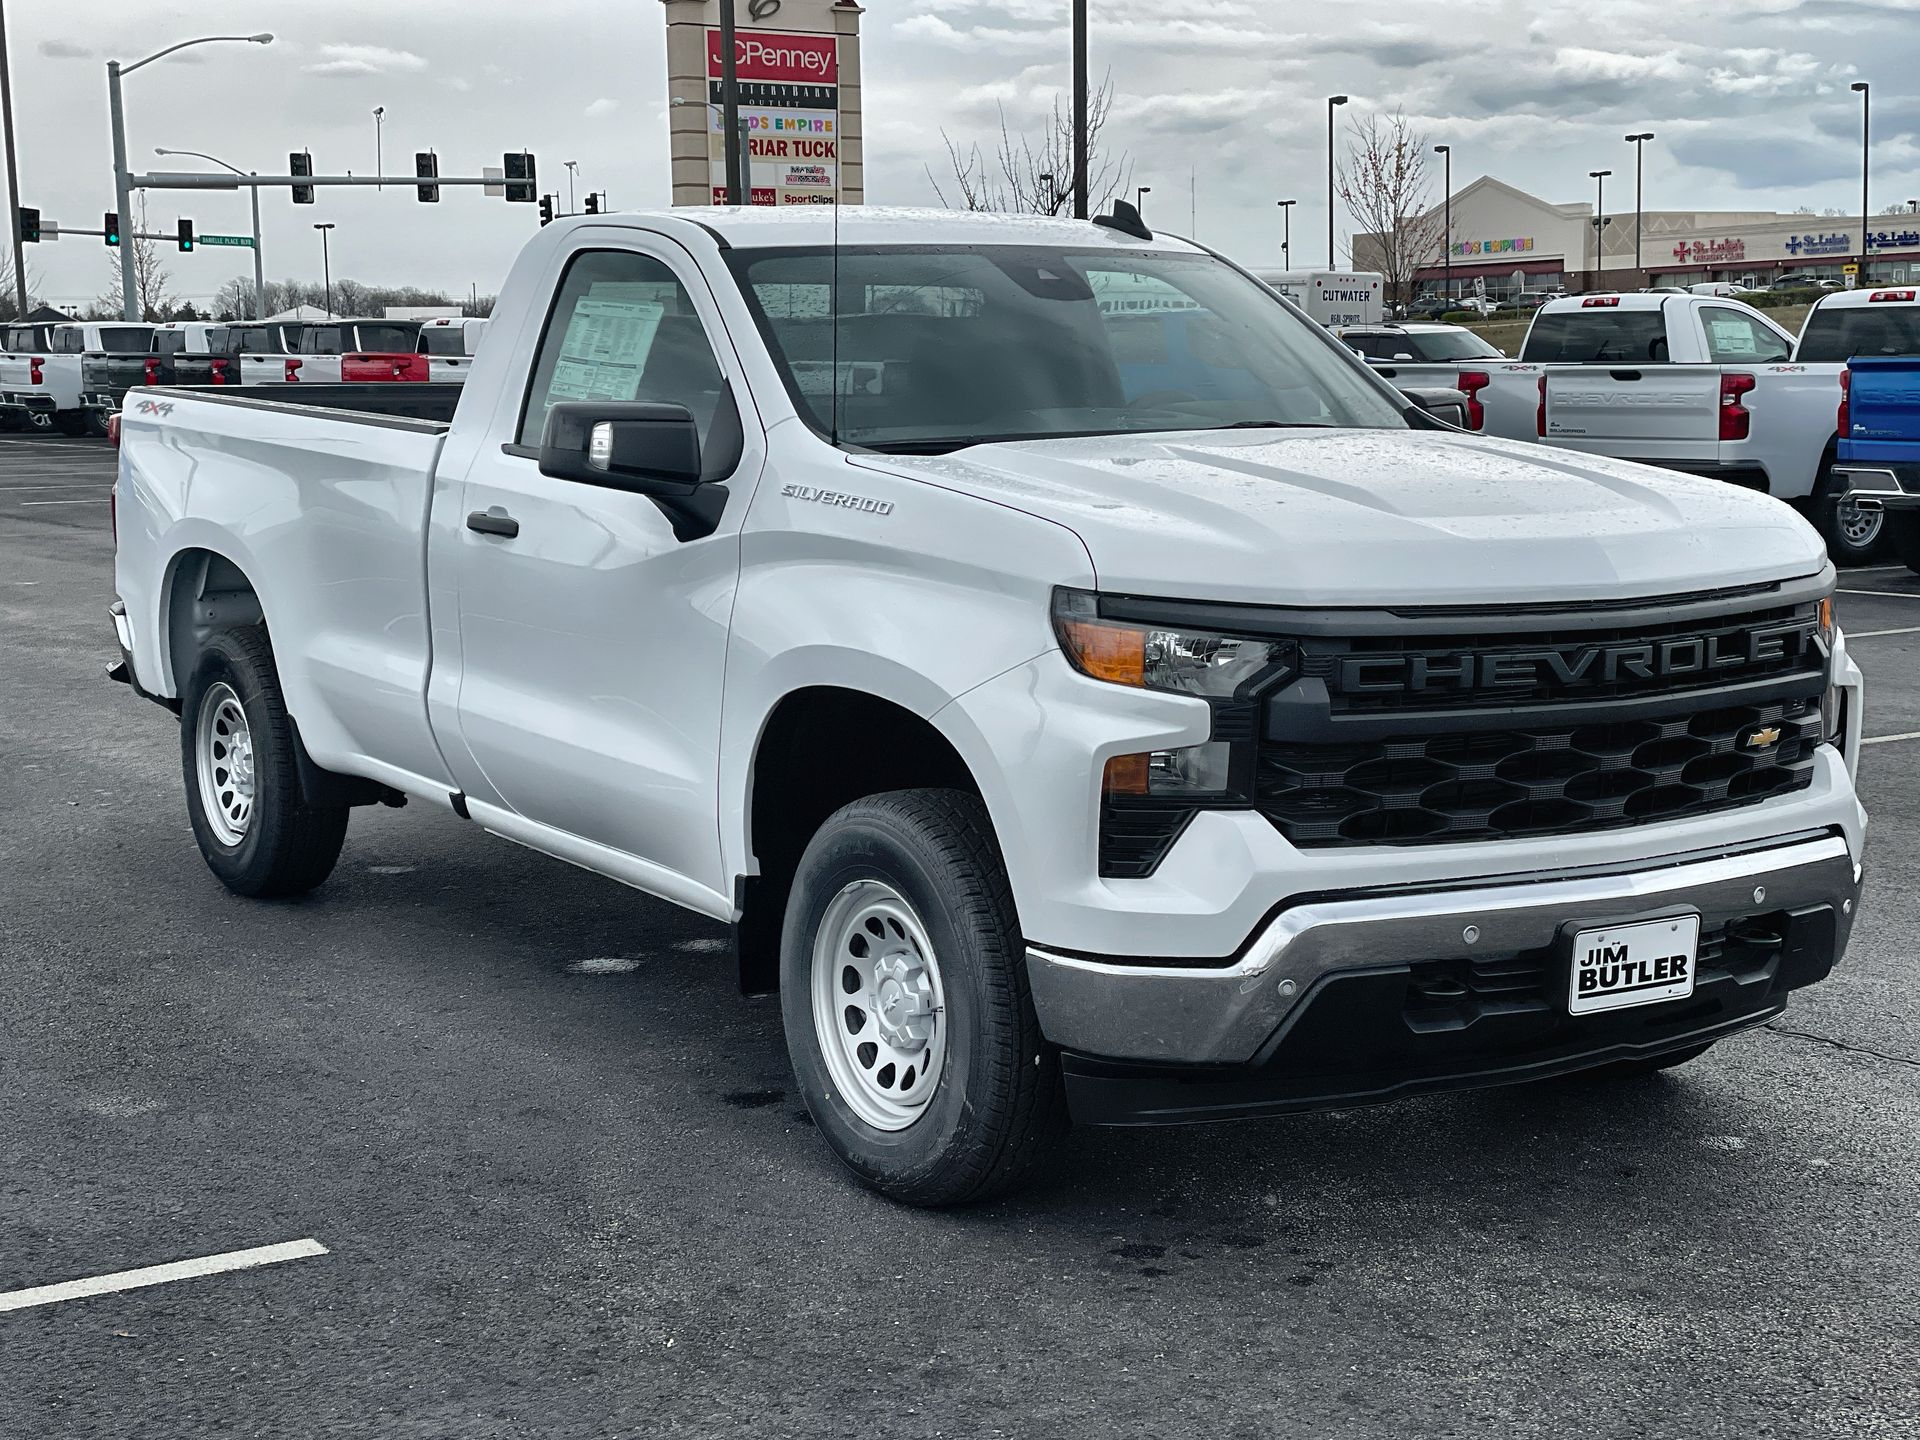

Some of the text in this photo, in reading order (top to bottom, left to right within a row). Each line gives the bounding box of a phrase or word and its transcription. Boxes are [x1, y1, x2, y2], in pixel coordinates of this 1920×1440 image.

[749, 99, 800, 107] OUTLET
[775, 118, 833, 132] EMPIRE
[748, 138, 836, 159] RIAR TUCK
[750, 191, 775, 203] uke's
[1450, 236, 1534, 256] KIDS EMPIRE
[1322, 289, 1371, 302] CUTWATER
[1330, 314, 1361, 324] REAL SPIRITS
[1553, 391, 1707, 406] CHEVROLET
[781, 483, 895, 516] SILVERADO
[1341, 620, 1818, 693] CHEVROLET
[1579, 944, 1629, 968] JIM
[1578, 954, 1688, 992] BUTLER
